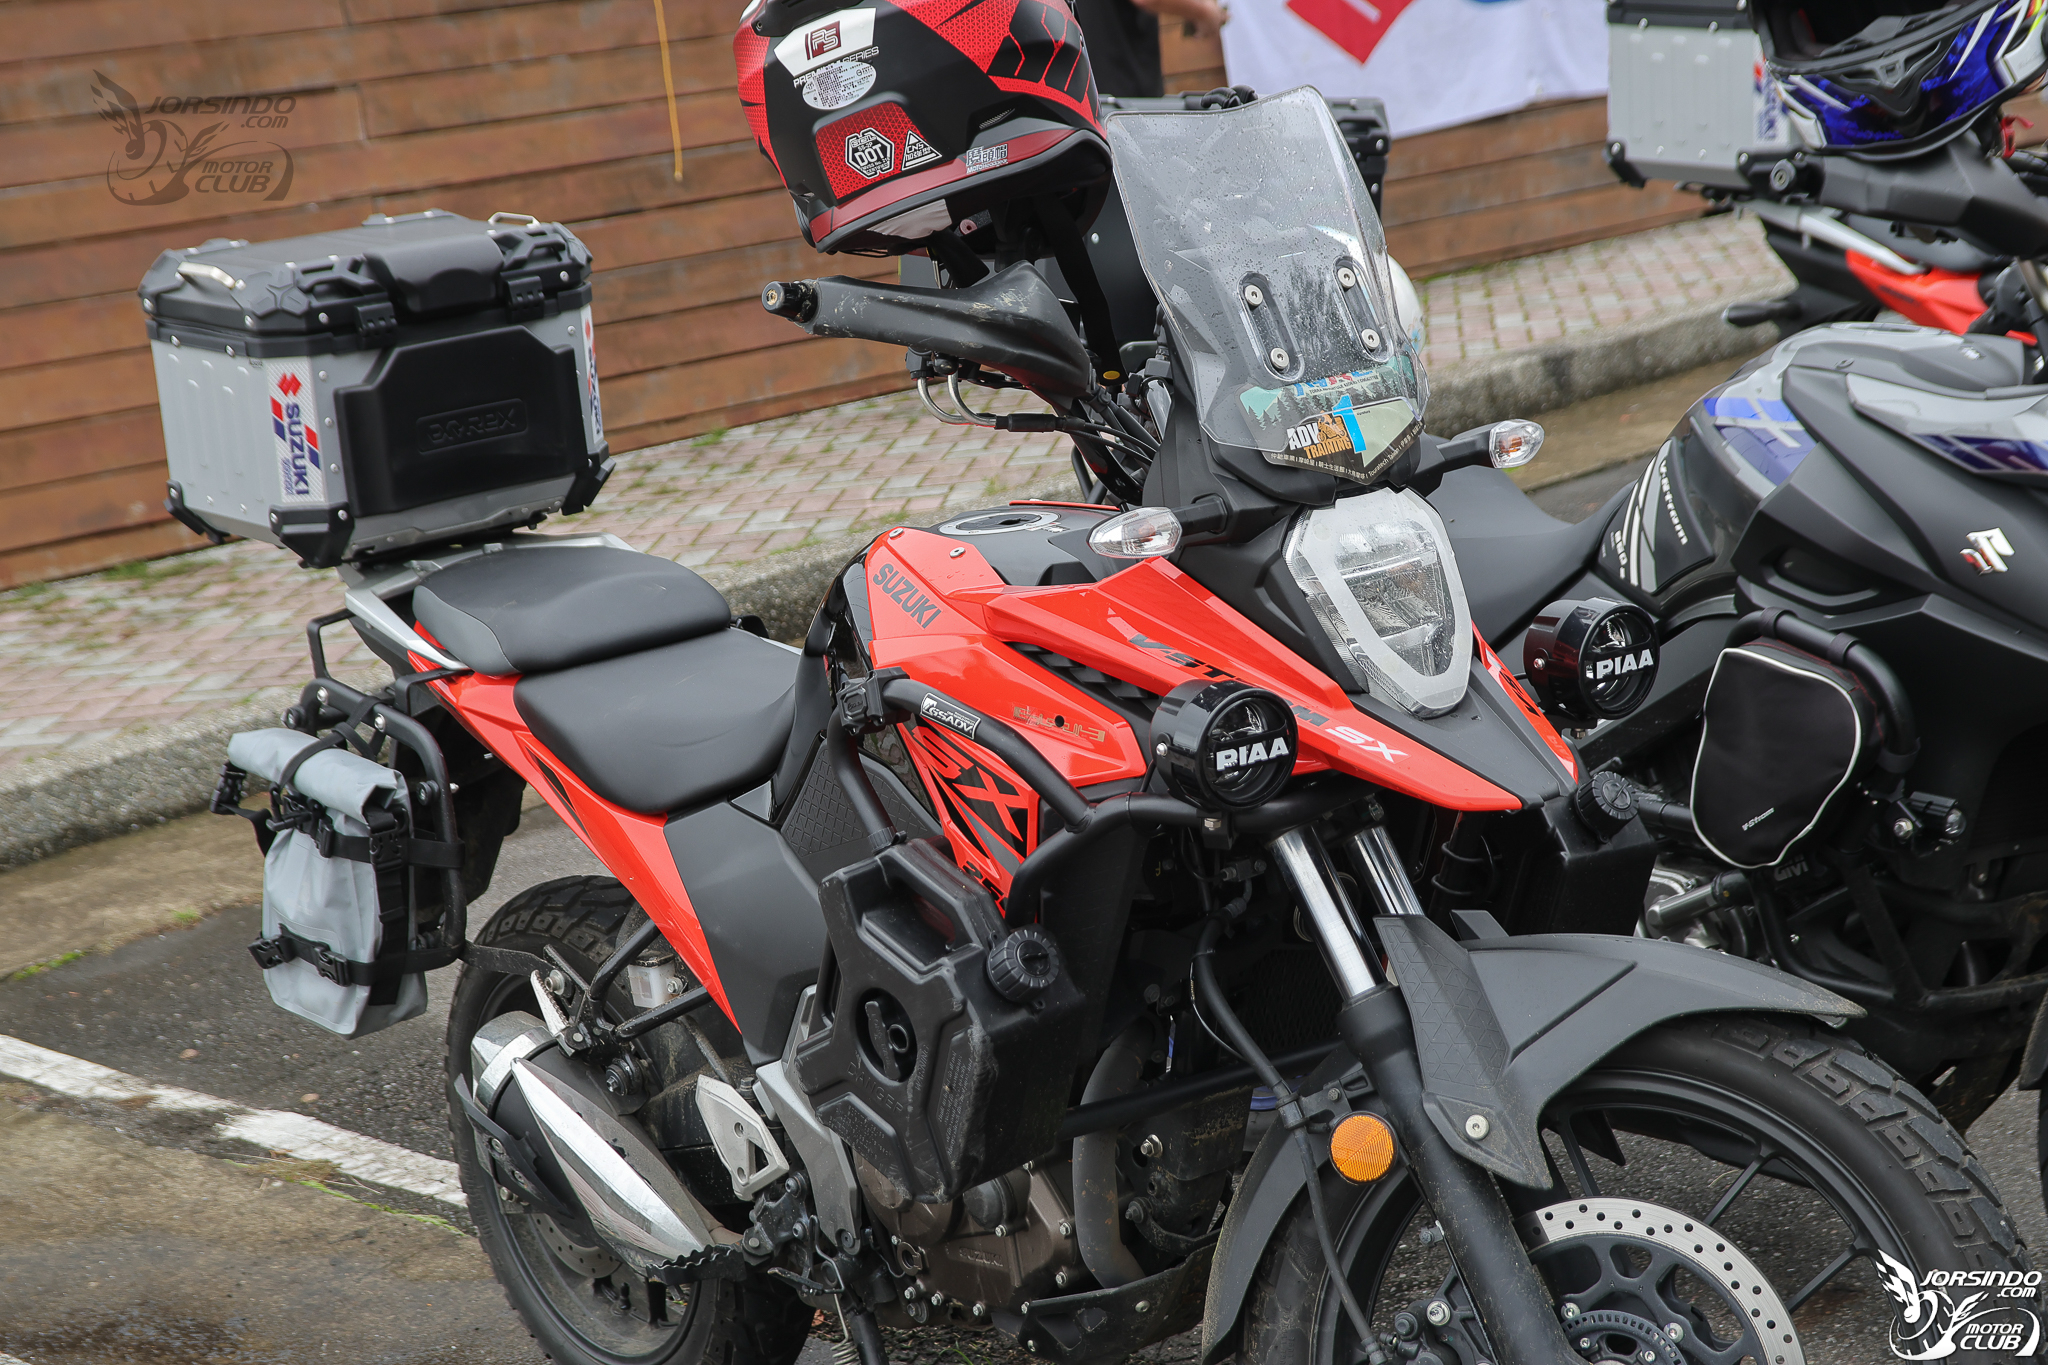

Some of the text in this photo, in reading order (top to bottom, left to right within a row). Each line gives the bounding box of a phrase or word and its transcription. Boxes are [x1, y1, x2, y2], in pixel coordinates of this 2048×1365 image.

[842, 46, 880, 63] SERIES
[854, 143, 884, 167] DOT
[906, 141, 924, 154] CNS
[285, 401, 310, 496] SUZUKI
[1286, 422, 1320, 451] ADV
[1303, 438, 1353, 460] TRAINING
[873, 563, 942, 629] SUZUKI
[1595, 648, 1655, 680] PIAA
[1128, 633, 1409, 764] V-STM SX
[1215, 736, 1291, 772] PIAA
[958, 1246, 1004, 1267] SUZUKI
